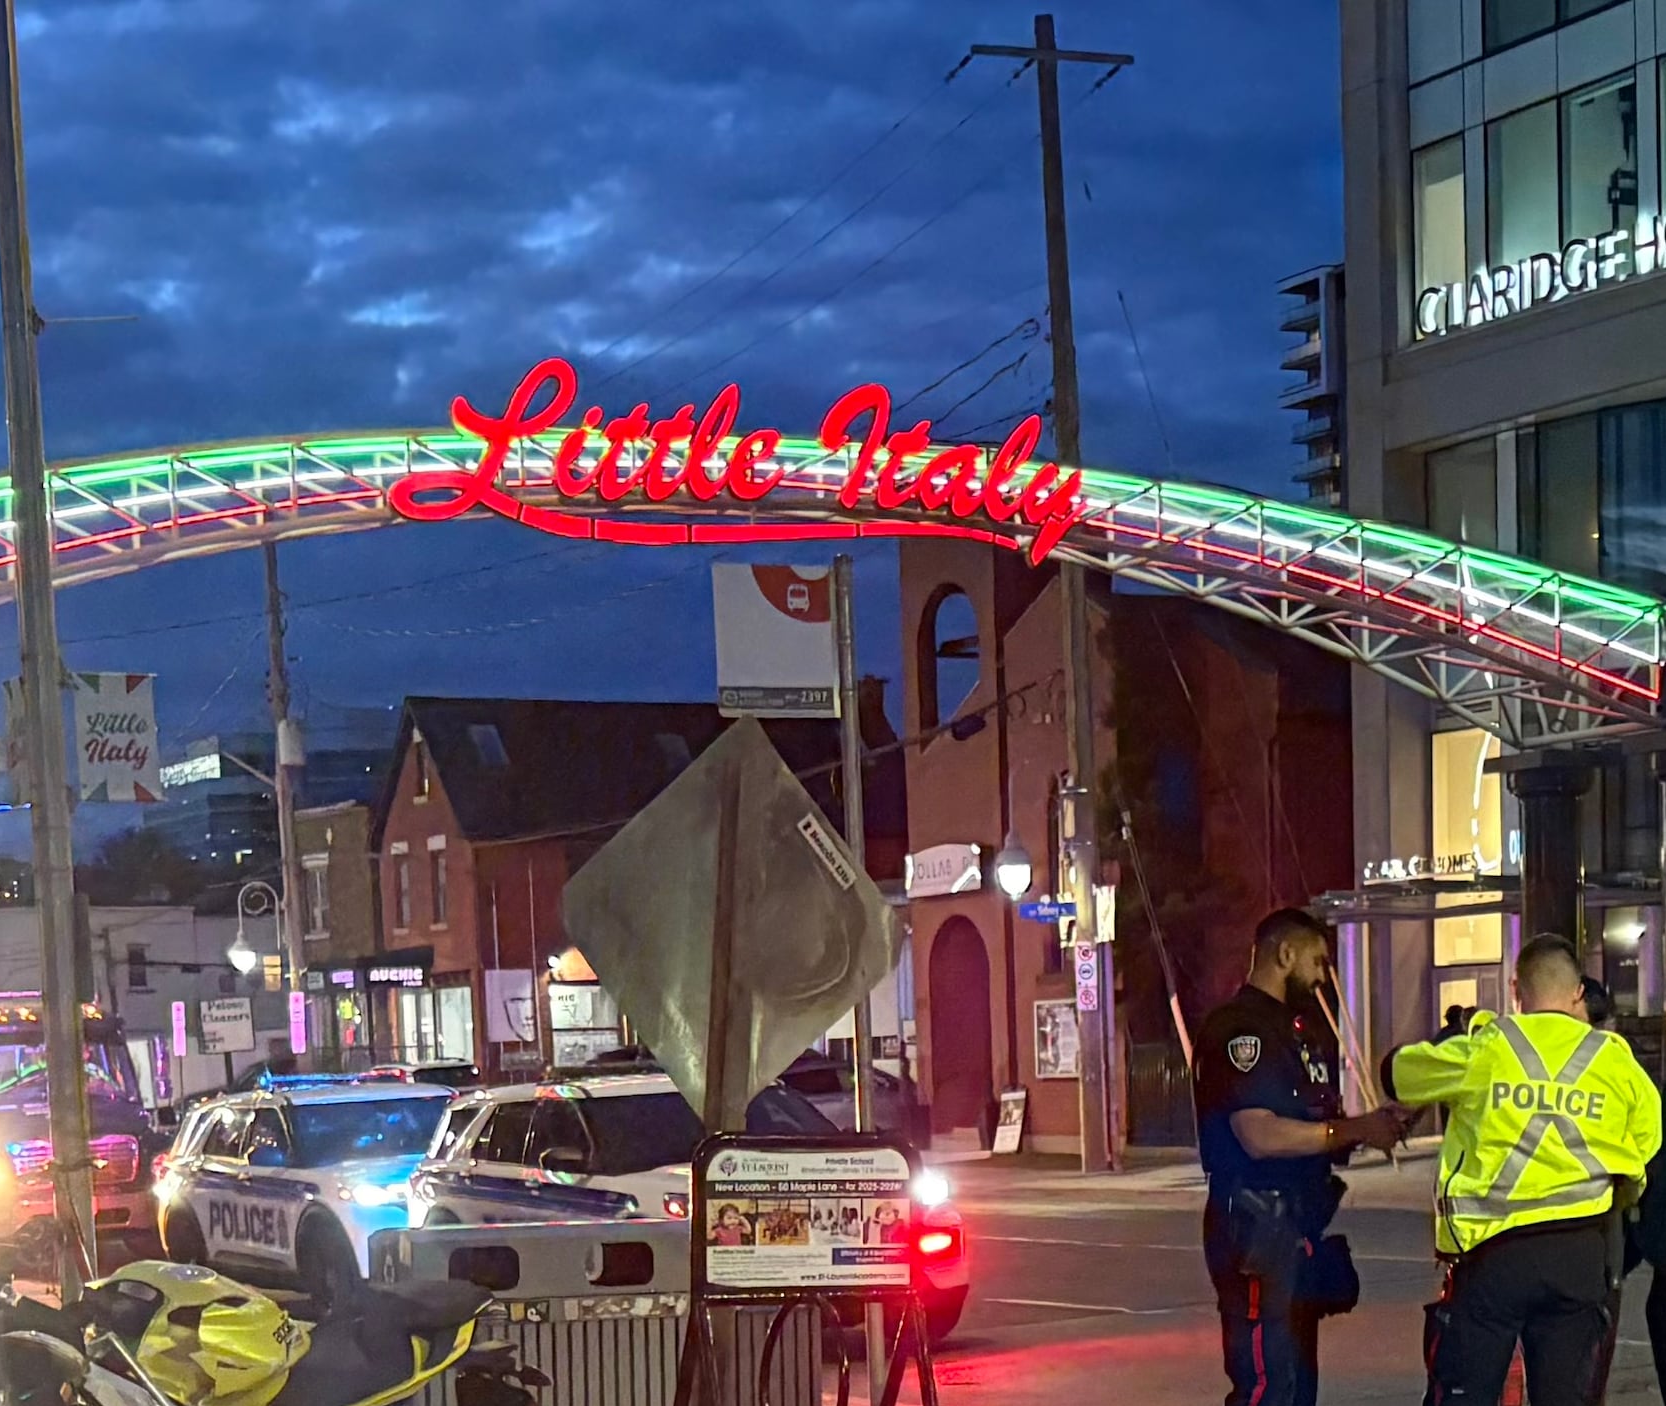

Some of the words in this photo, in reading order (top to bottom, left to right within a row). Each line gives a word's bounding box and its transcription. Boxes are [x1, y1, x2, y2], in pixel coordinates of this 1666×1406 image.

[389, 357, 783, 524] Little
[819, 382, 1085, 567] Italy
[86, 711, 149, 737] Little
[85, 738, 149, 770] Italy
[1492, 1081, 1606, 1121] POLICE
[715, 1183, 733, 1192] New
[734, 1183, 771, 1192] Location
[790, 1182, 816, 1193] Maple
[817, 1182, 838, 1192] Lane
[209, 1200, 276, 1246] POLICE
